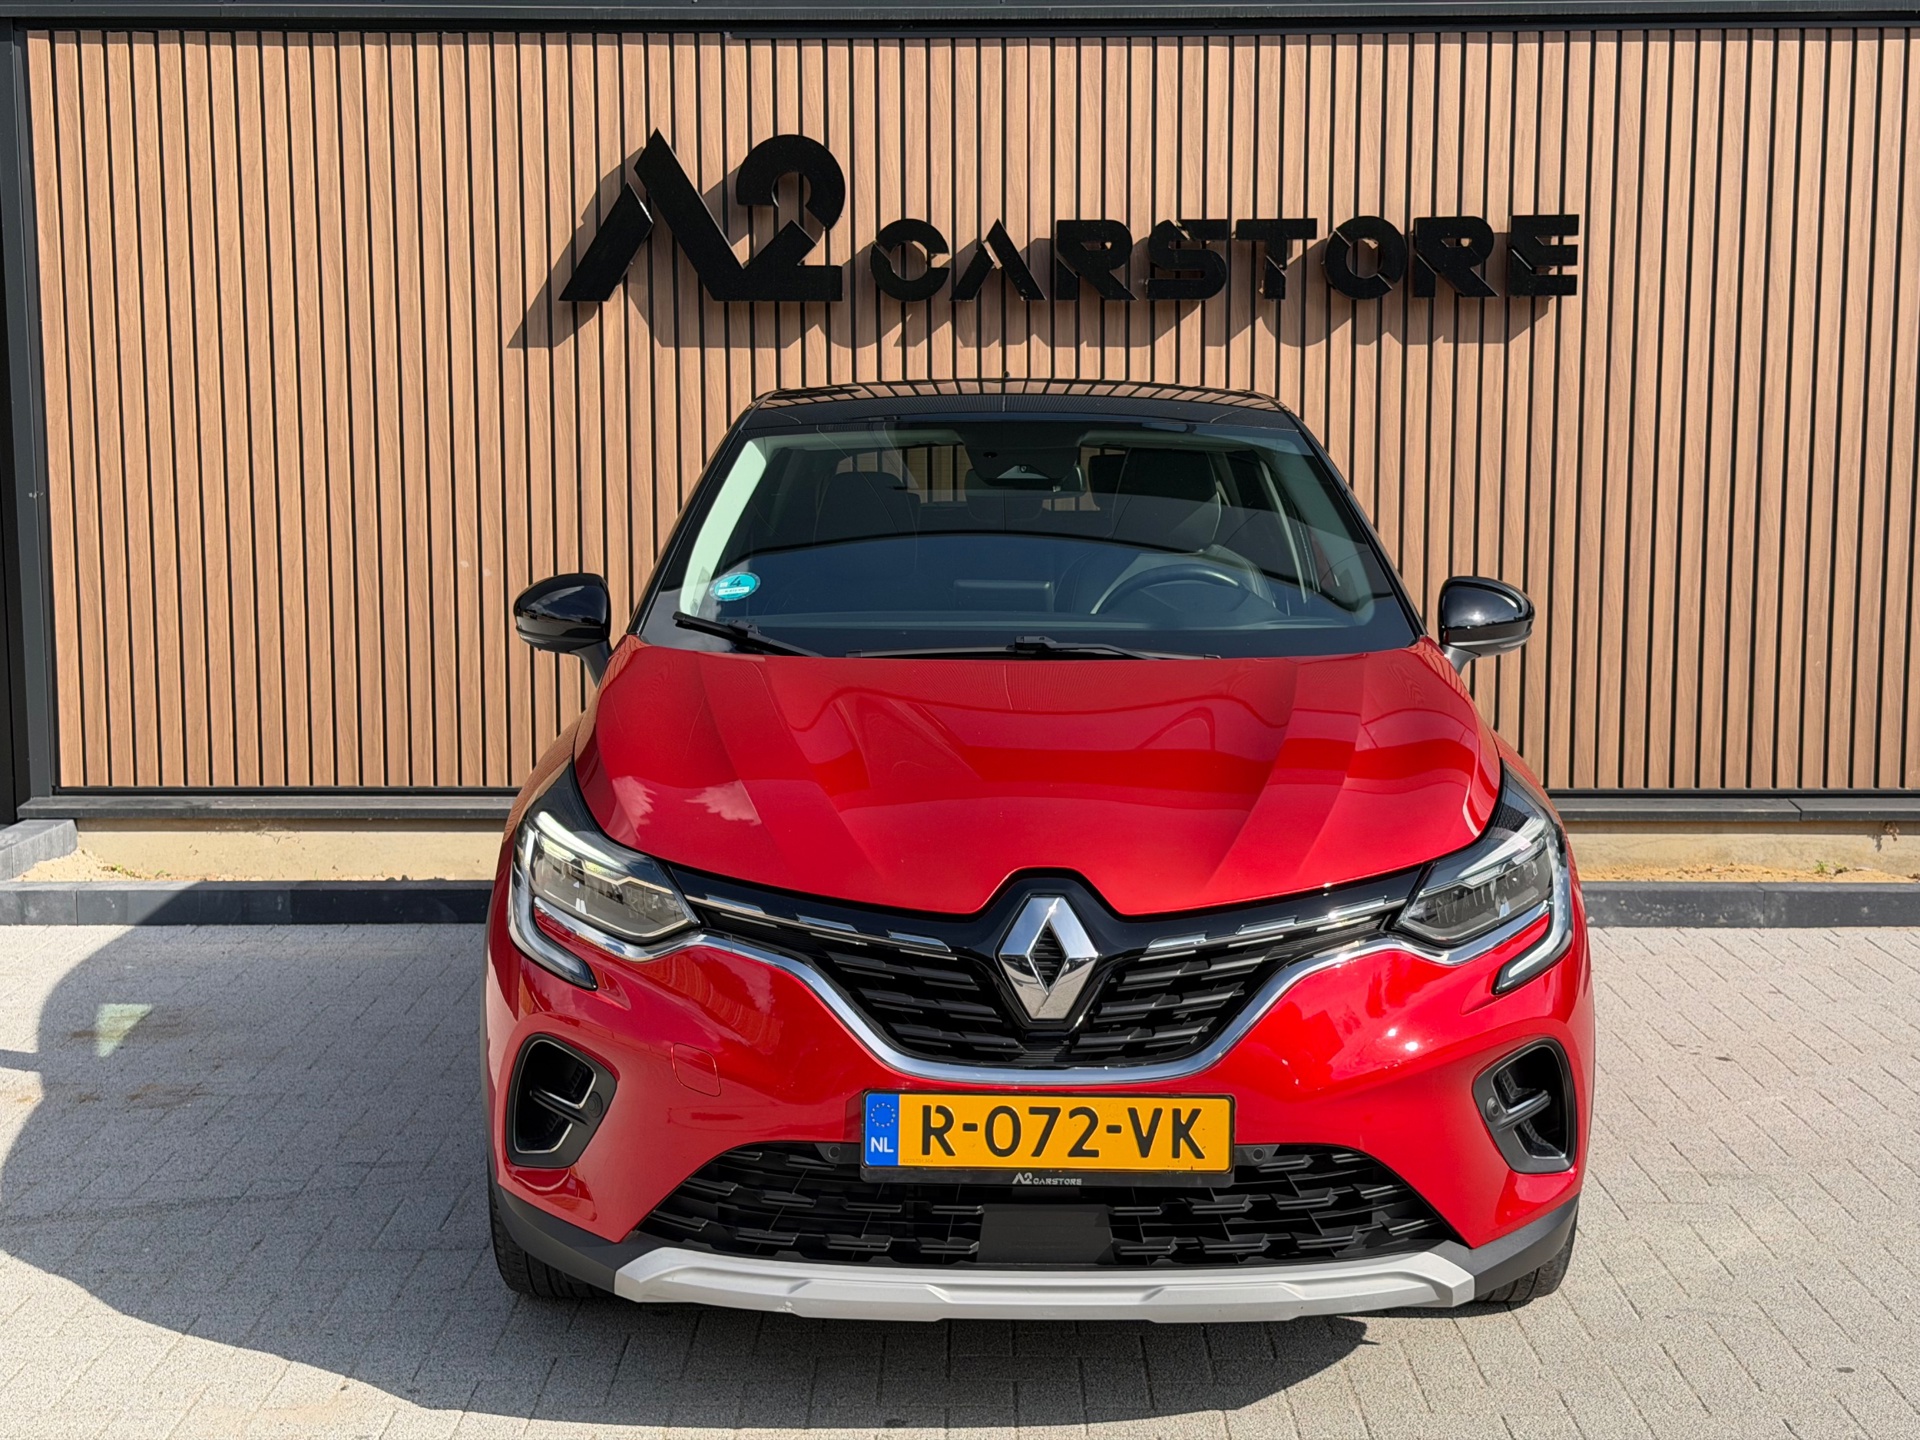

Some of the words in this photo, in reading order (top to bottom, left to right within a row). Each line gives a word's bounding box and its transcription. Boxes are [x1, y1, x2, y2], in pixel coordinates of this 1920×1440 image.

[558, 127, 846, 302] A2
[870, 214, 1580, 302] CARSTORE
[730, 575, 742, 587] 4
[921, 1104, 1206, 1160] R-072-VK
[870, 1136, 895, 1153] NL
[1012, 1172, 1033, 1185] A2
[1033, 1177, 1082, 1186] CARSTORE
